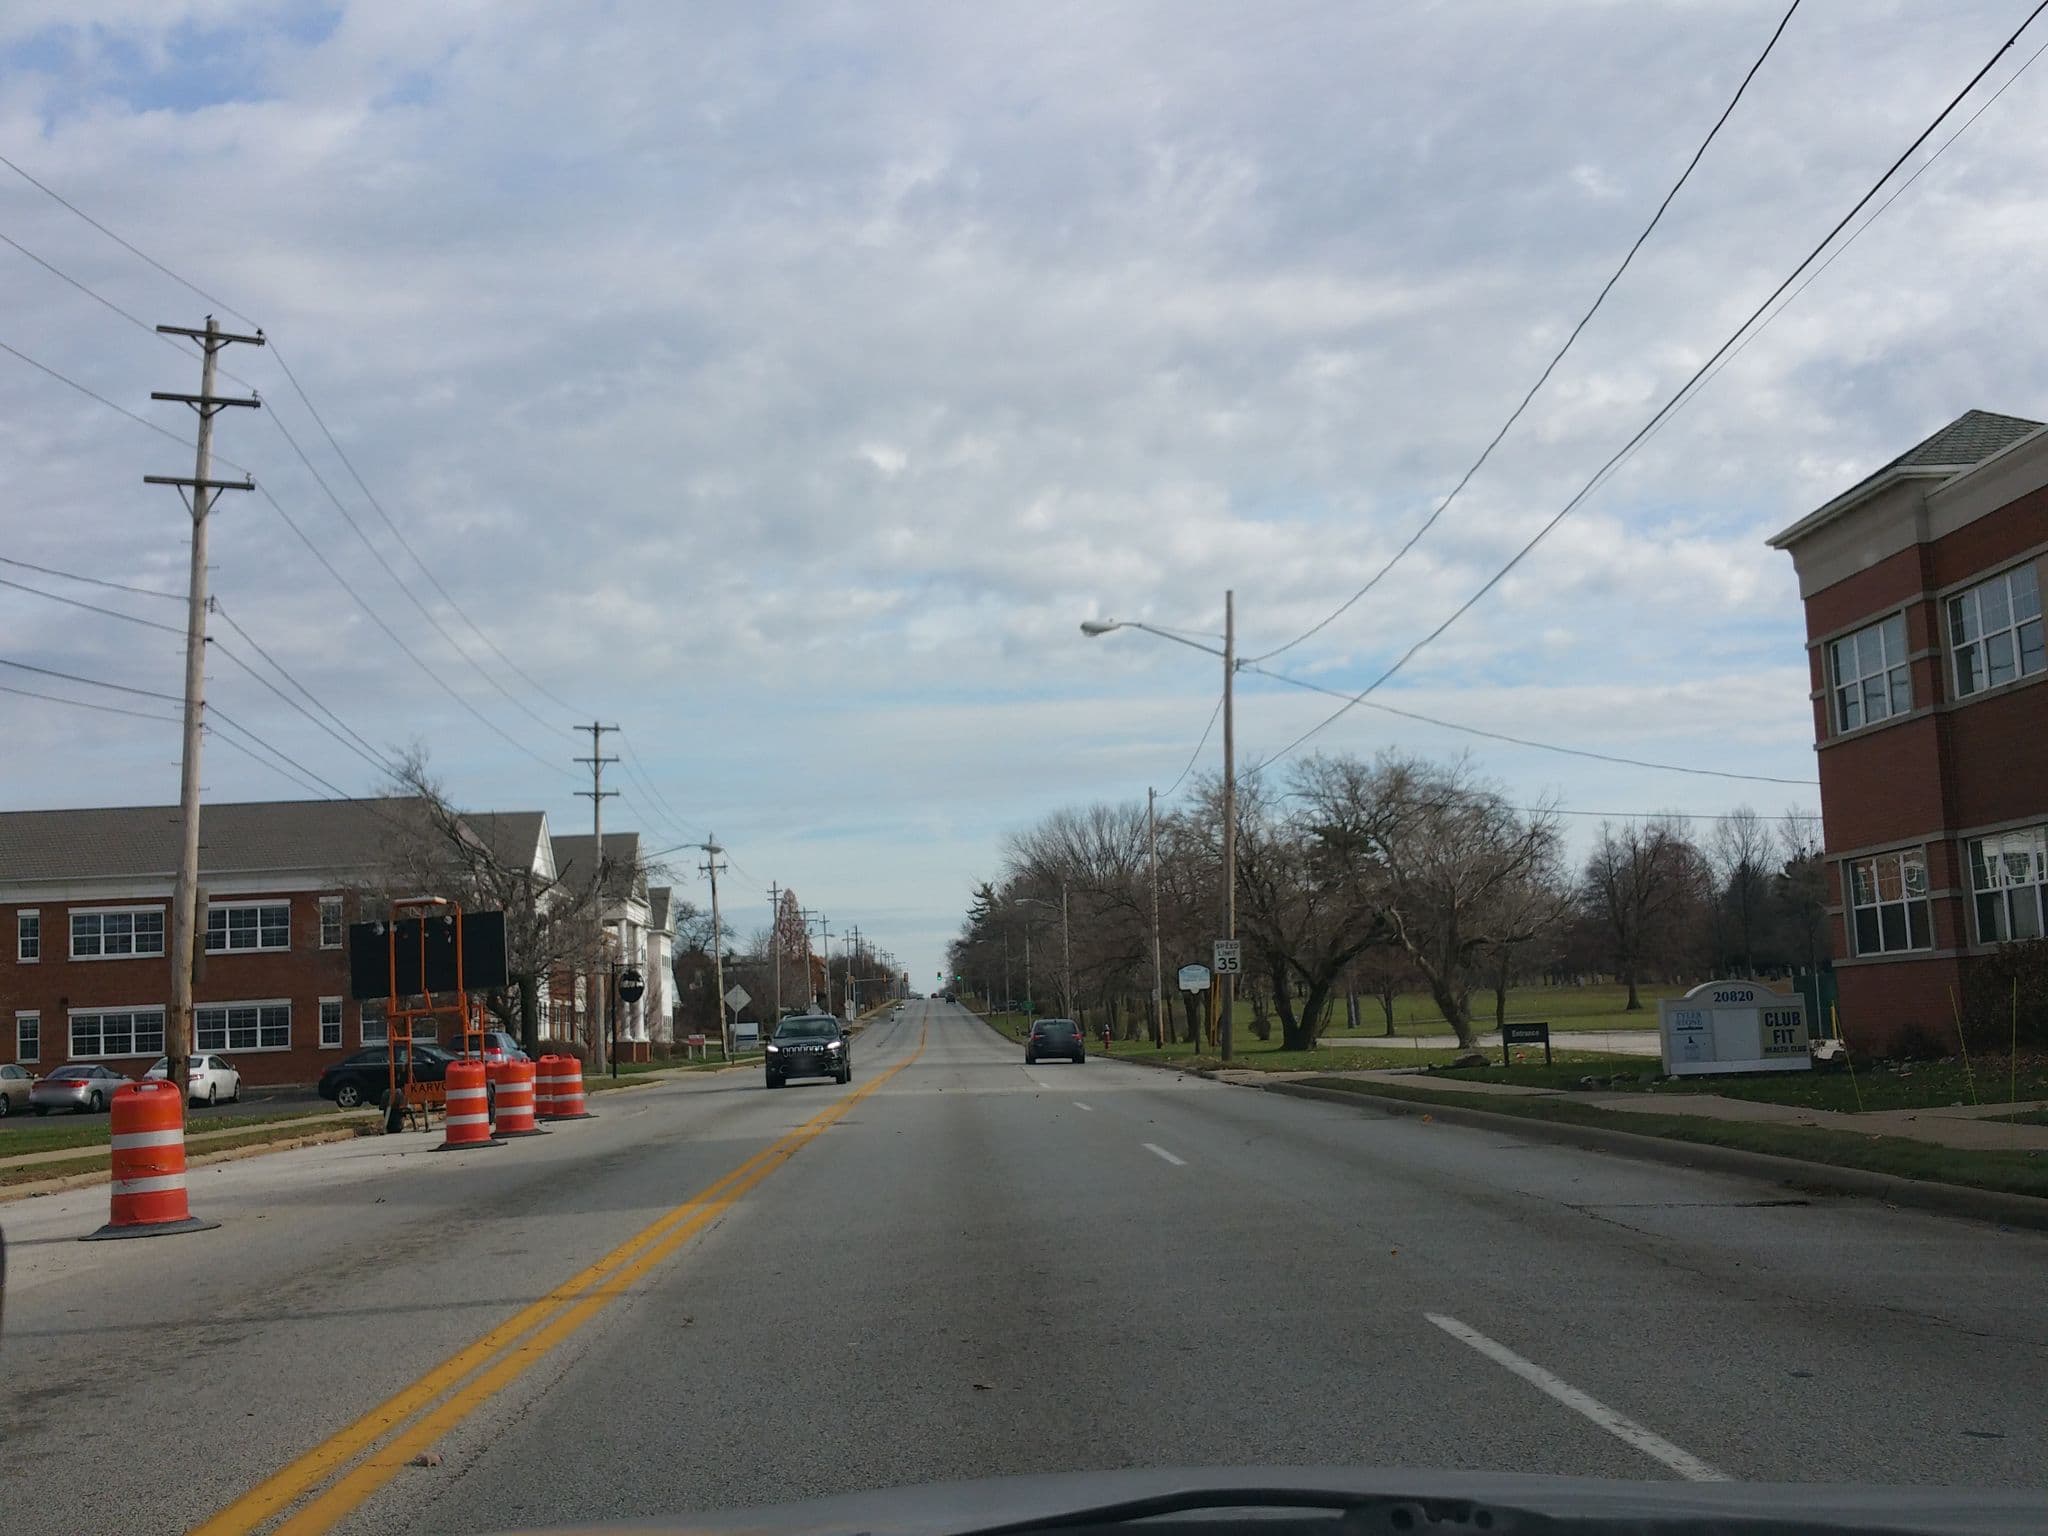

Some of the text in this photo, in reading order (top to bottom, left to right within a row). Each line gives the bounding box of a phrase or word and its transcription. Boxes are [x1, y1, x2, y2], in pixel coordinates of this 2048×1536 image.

[1218, 958, 1238, 970] 35
[1713, 990, 1754, 1002] 20820
[1765, 1011, 1801, 1026] CLUB
[1773, 1029, 1795, 1044] FIT
